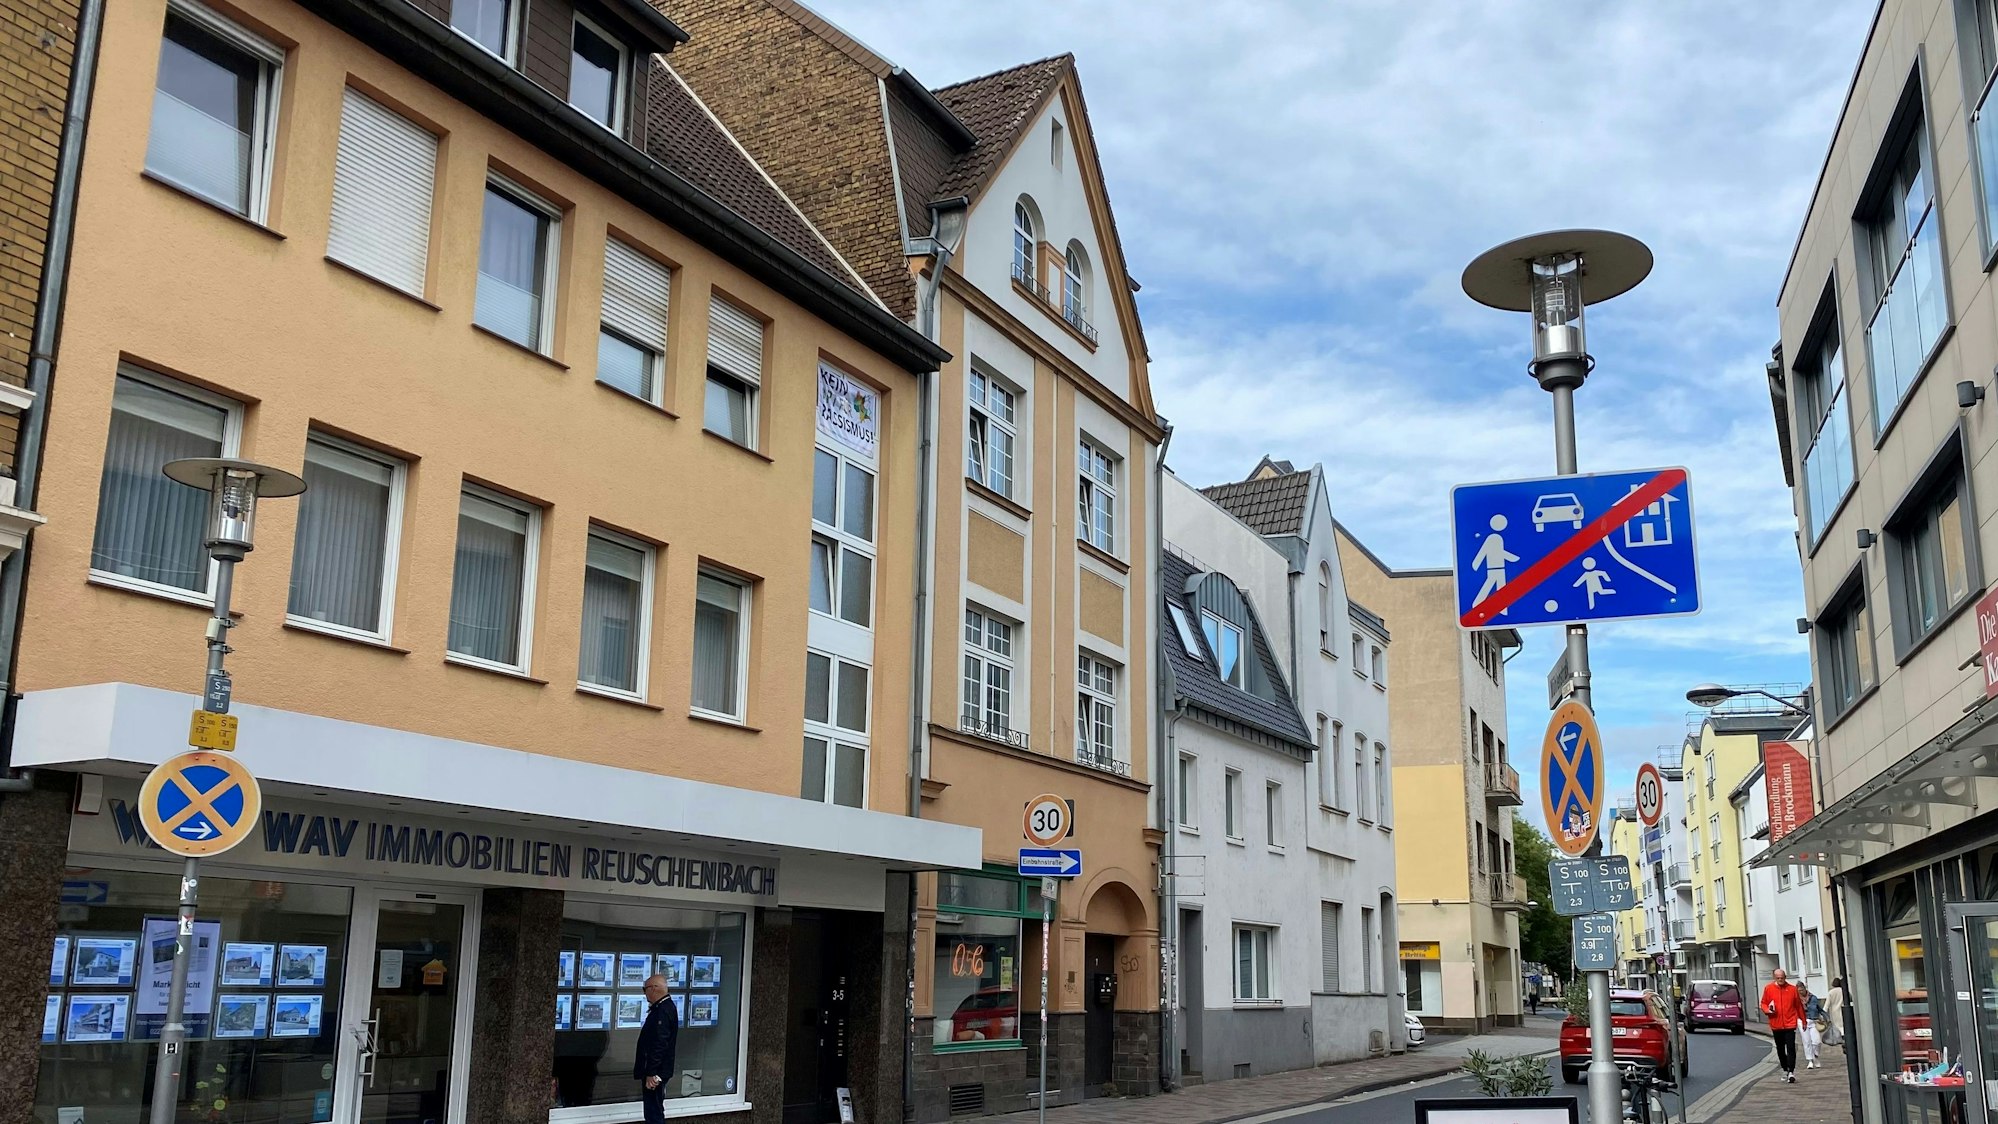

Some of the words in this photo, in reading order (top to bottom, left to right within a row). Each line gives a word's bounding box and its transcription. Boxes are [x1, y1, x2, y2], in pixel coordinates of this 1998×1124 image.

[821, 368, 848, 396] KEIN
[1981, 611, 1997, 645] Die
[1986, 652, 1998, 686] Ka
[215, 682, 220, 690] S
[1641, 780, 1656, 809] 30
[1782, 763, 1795, 822] Brockmann
[1770, 777, 1783, 842] Buchhandlung
[1034, 809, 1059, 832] 30
[263, 811, 358, 857] WAV
[367, 823, 571, 878] IMMOBILIEN
[582, 847, 775, 896] REUSCHENBACH
[1560, 867, 1570, 879] S
[1574, 870, 1589, 878] 100
[1600, 864, 1609, 876] S
[1614, 867, 1628, 875] 100
[1618, 882, 1629, 891] 0.7
[1571, 898, 1582, 906] 2.3
[1610, 895, 1622, 904] 2.7
[1584, 922, 1592, 933] S
[1581, 942, 1592, 950] 3.9
[833, 990, 844, 1000] 3-5
